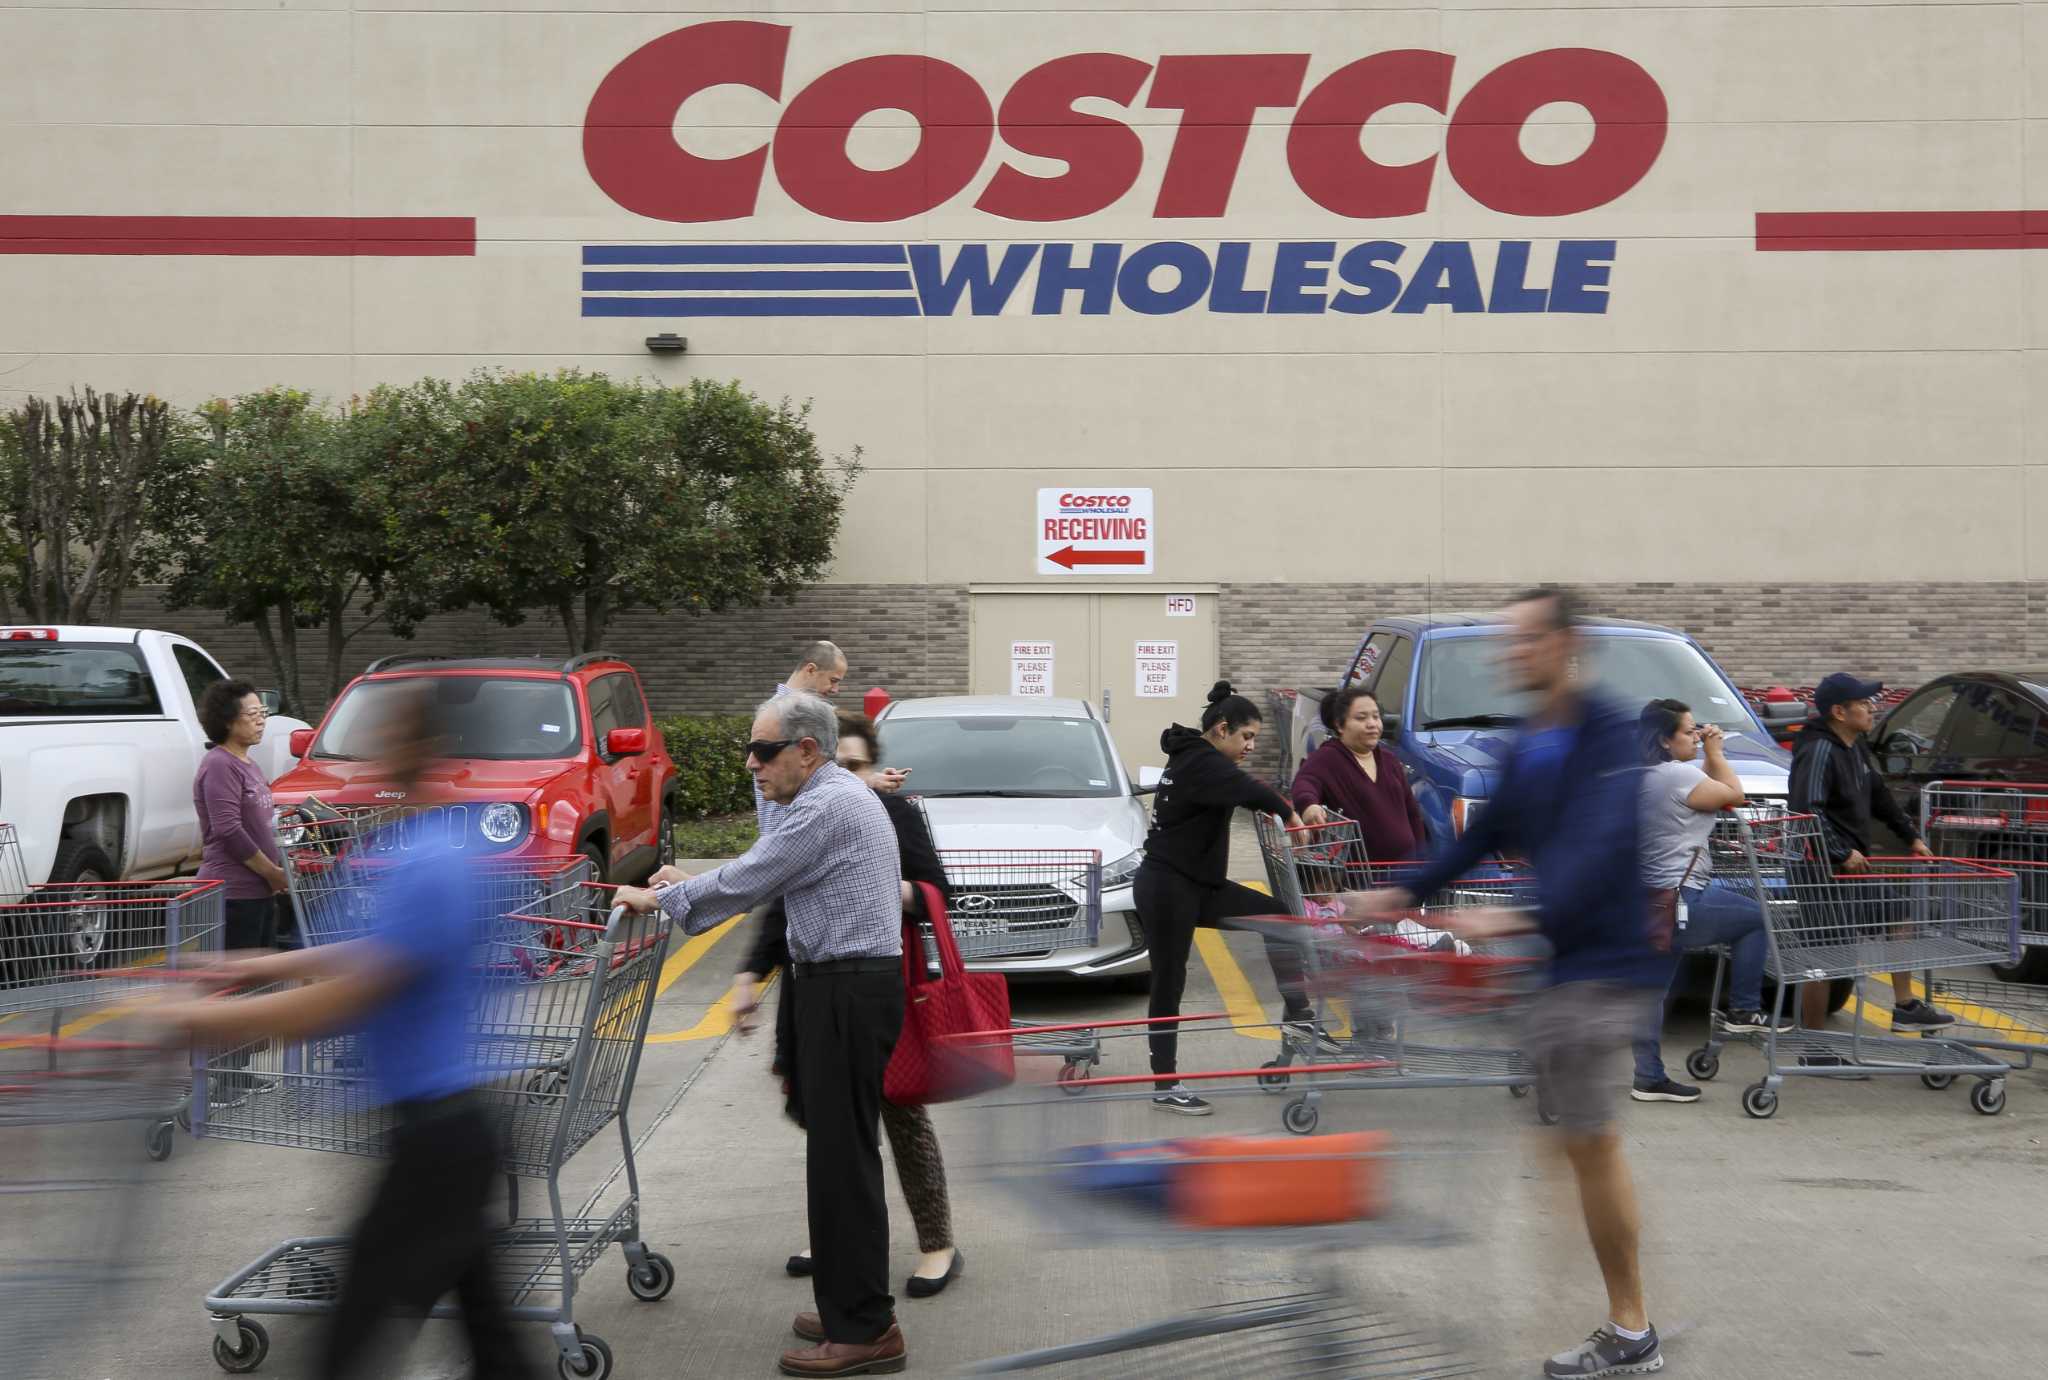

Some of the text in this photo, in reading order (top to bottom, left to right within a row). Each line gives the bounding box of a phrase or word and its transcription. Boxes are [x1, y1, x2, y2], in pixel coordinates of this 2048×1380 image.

[583, 20, 1669, 222] COSTCO
[909, 240, 1617, 316] WHOLESALE
[1059, 493, 1131, 507] COSTCO
[1044, 518, 1147, 540] RECEIVING
[1168, 598, 1194, 612] HFD
[1014, 645, 1051, 655] FIRE EXIT
[1138, 645, 1175, 655] FIRE EXIT
[1017, 662, 1048, 672] PLEASE
[1141, 662, 1172, 672] PLEASE
[1022, 674, 1043, 683] KEEP
[1146, 674, 1167, 683] KEEP
[1019, 685, 1046, 695] CLEAR
[1143, 685, 1169, 695] CLEAR
[374, 790, 407, 800] Jeep
